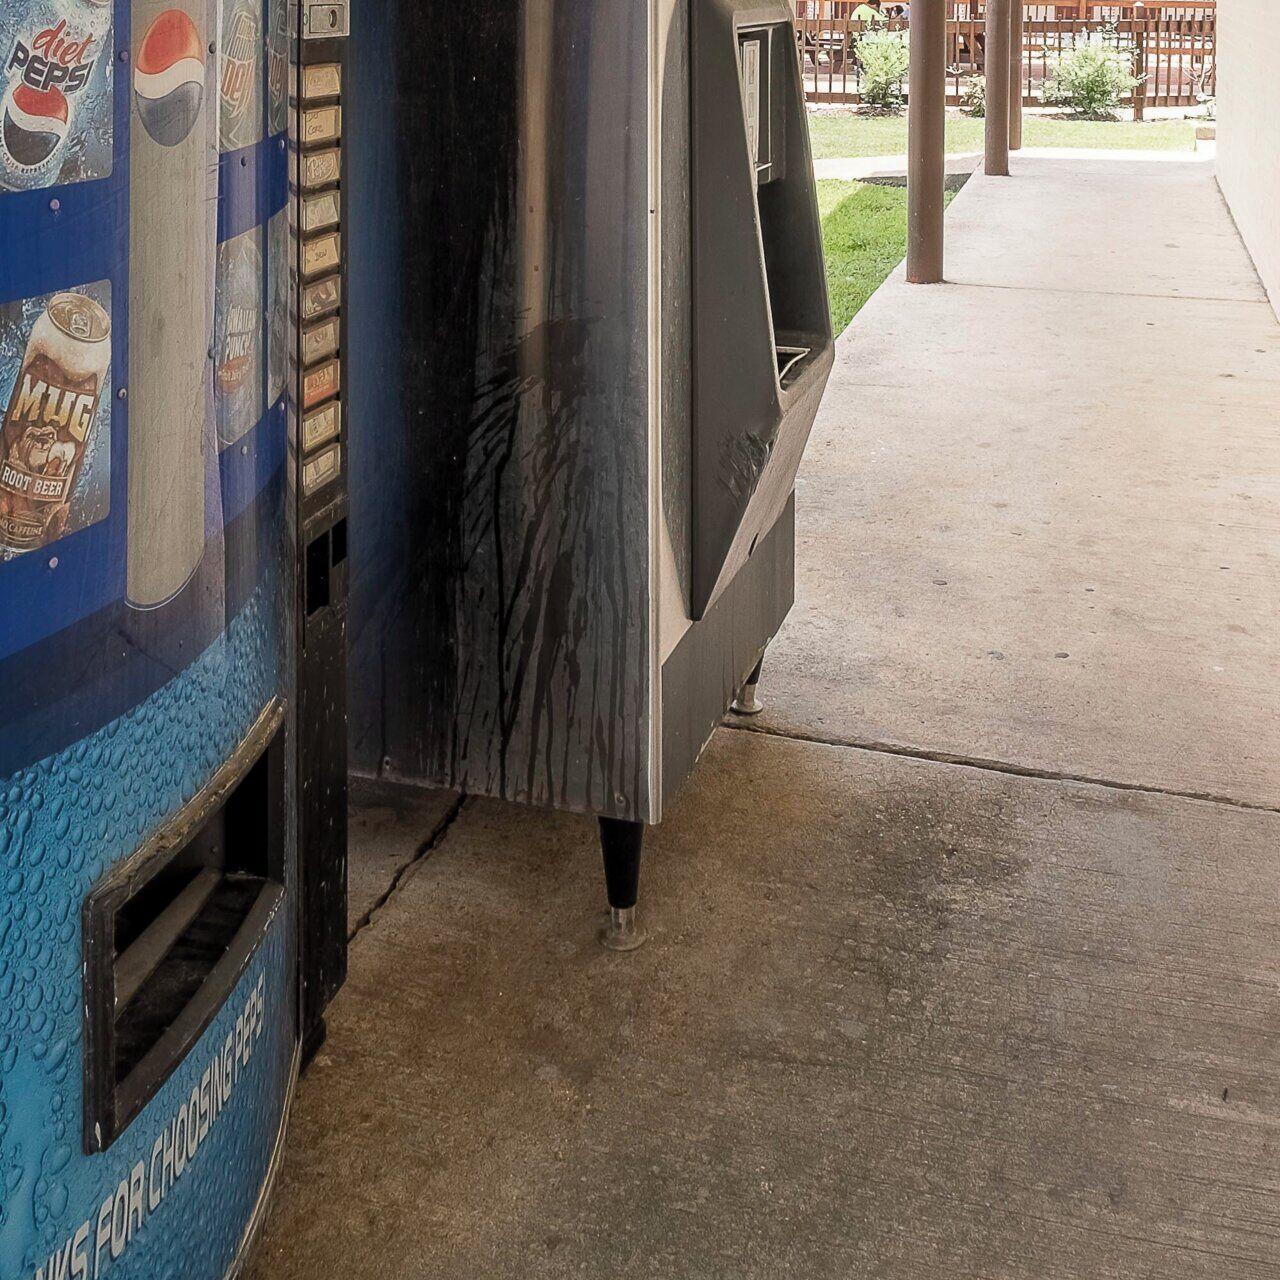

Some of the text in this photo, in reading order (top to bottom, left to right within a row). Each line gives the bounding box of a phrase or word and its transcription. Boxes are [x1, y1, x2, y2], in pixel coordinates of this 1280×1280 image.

[8, 39, 93, 94] PEPSI
[33, 18, 96, 66] diet
[11, 378, 95, 443] MUG
[2, 465, 65, 498] ROOT BEER
[8, 522, 44, 536] CAFFEINE
[93, 1159, 146, 1280] FOR
[147, 1030, 233, 1212] CHOOSING
